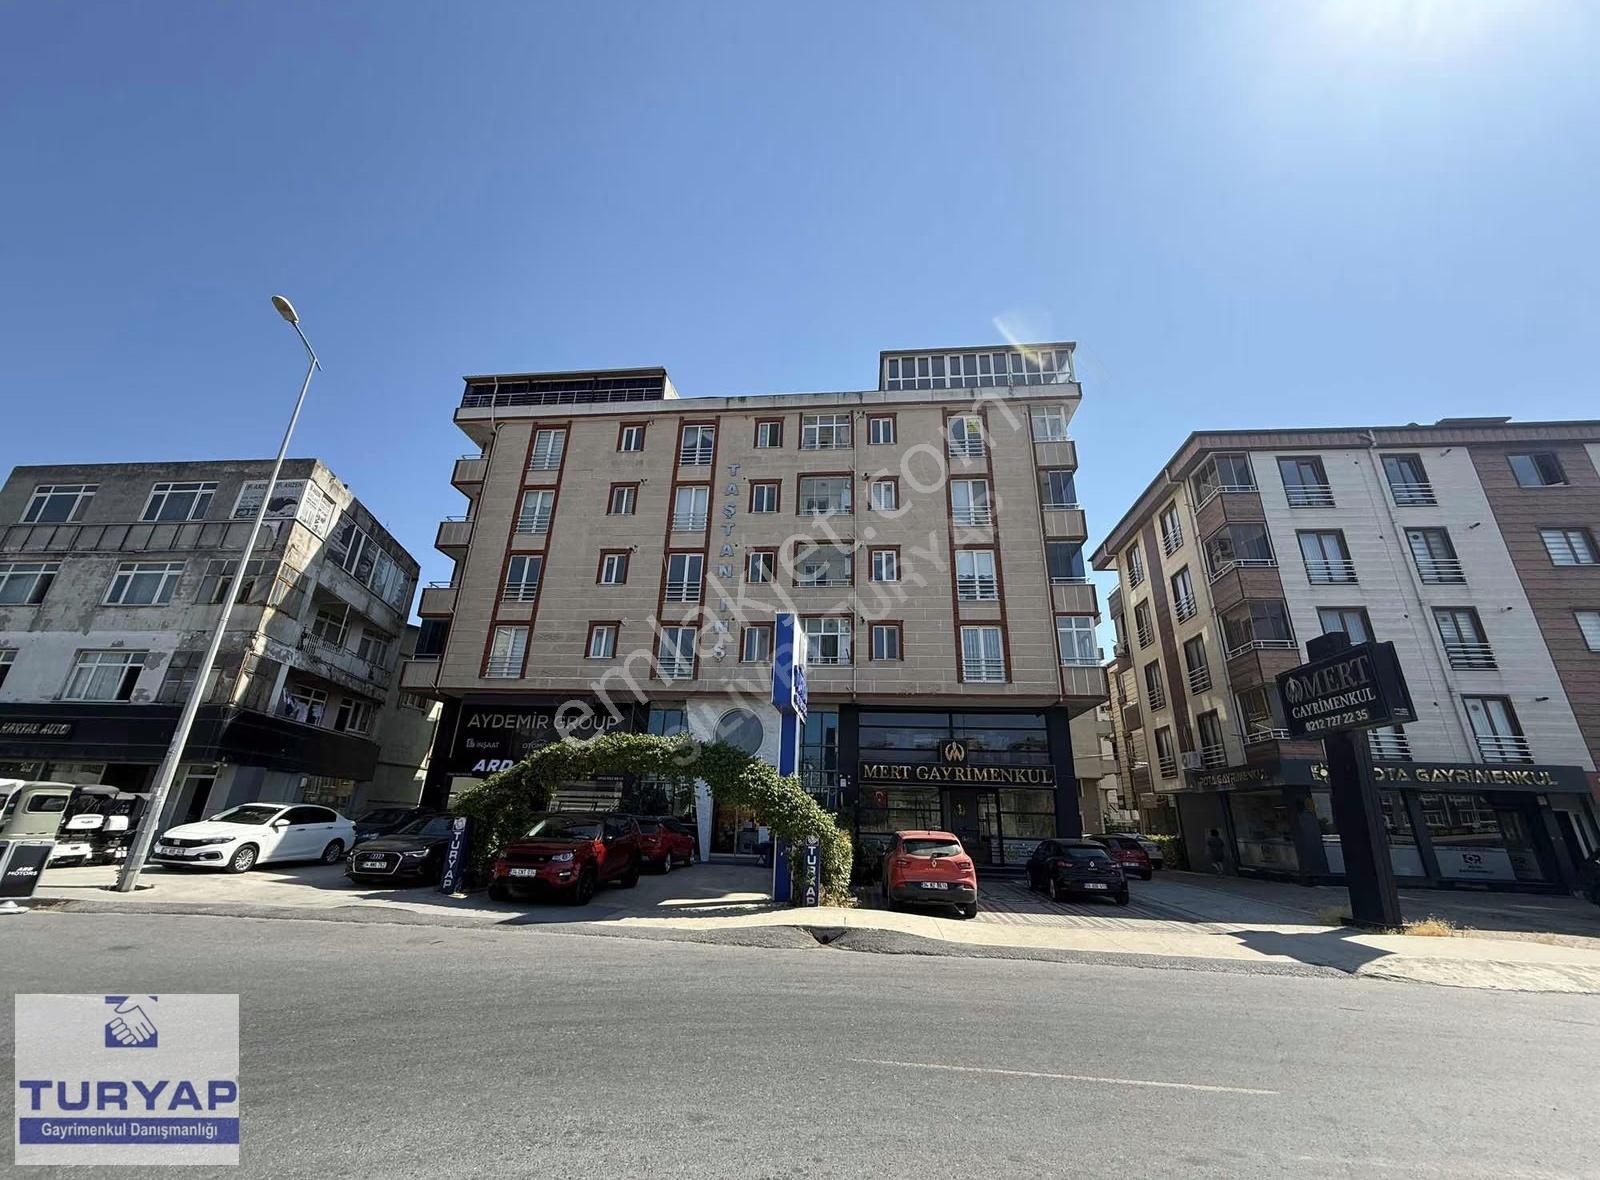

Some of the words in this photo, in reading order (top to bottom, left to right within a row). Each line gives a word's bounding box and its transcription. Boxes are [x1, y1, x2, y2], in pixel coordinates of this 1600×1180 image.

[717, 463, 741, 579] TAŞTAN
[1302, 655, 1371, 699] MERT
[1292, 687, 1376, 719] GAYRİMENKUL
[40, 723, 72, 735] AUTO
[467, 711, 549, 729] AYDEMİR
[553, 715, 619, 730] GROUP
[1305, 719, 1327, 732] 0212
[1326, 715, 1341, 728] 727
[1343, 712, 1354, 724] 22
[1356, 709, 1369, 721] 35
[471, 759, 514, 772] ARD
[863, 764, 912, 779] MERT
[916, 764, 1053, 784] GAYRİMENKUL
[443, 831, 461, 888] TURYAP
